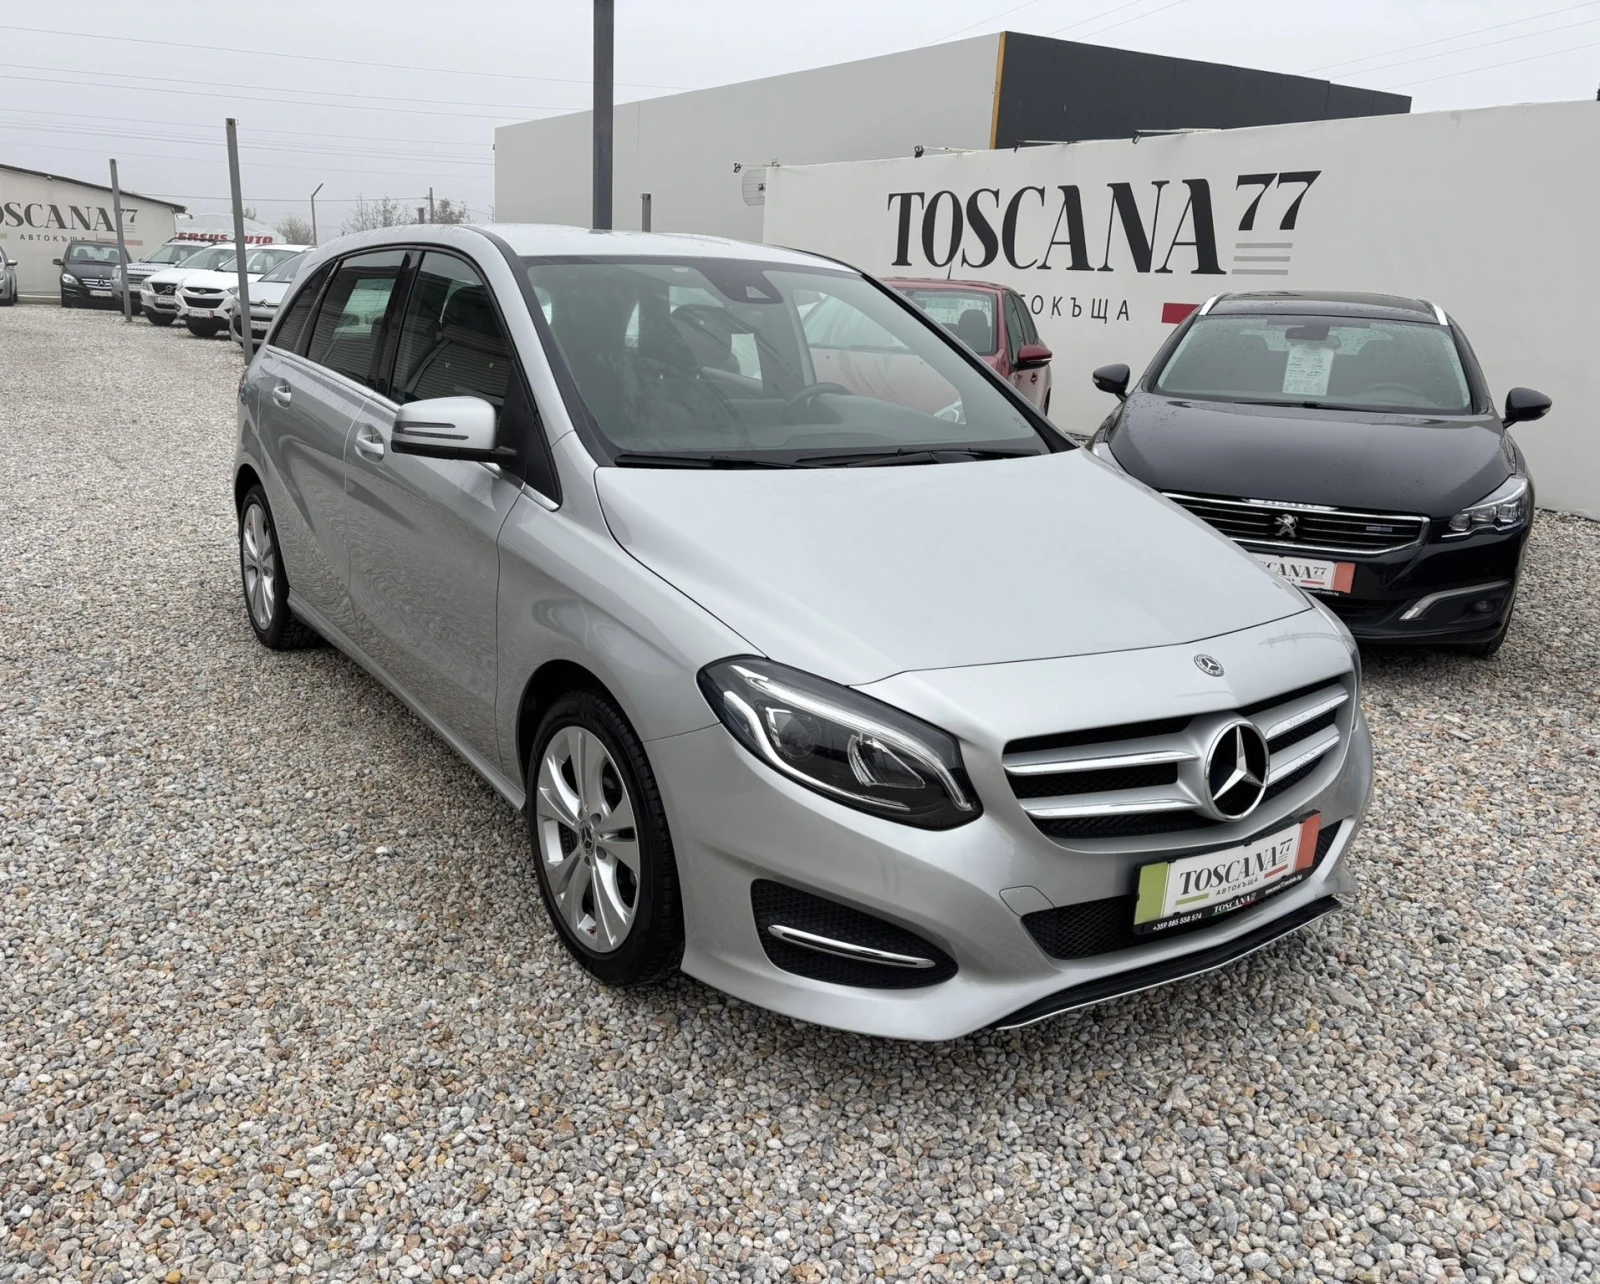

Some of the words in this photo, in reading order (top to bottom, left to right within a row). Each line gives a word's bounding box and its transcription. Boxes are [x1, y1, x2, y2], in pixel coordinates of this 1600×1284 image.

[0, 201, 117, 232] SCANA
[176, 232, 228, 243] ERSUS
[244, 235, 273, 244] UTO
[1020, 294, 1129, 324] ОКЪЩА
[1215, 878, 1258, 896] АВТОКЪЩА
